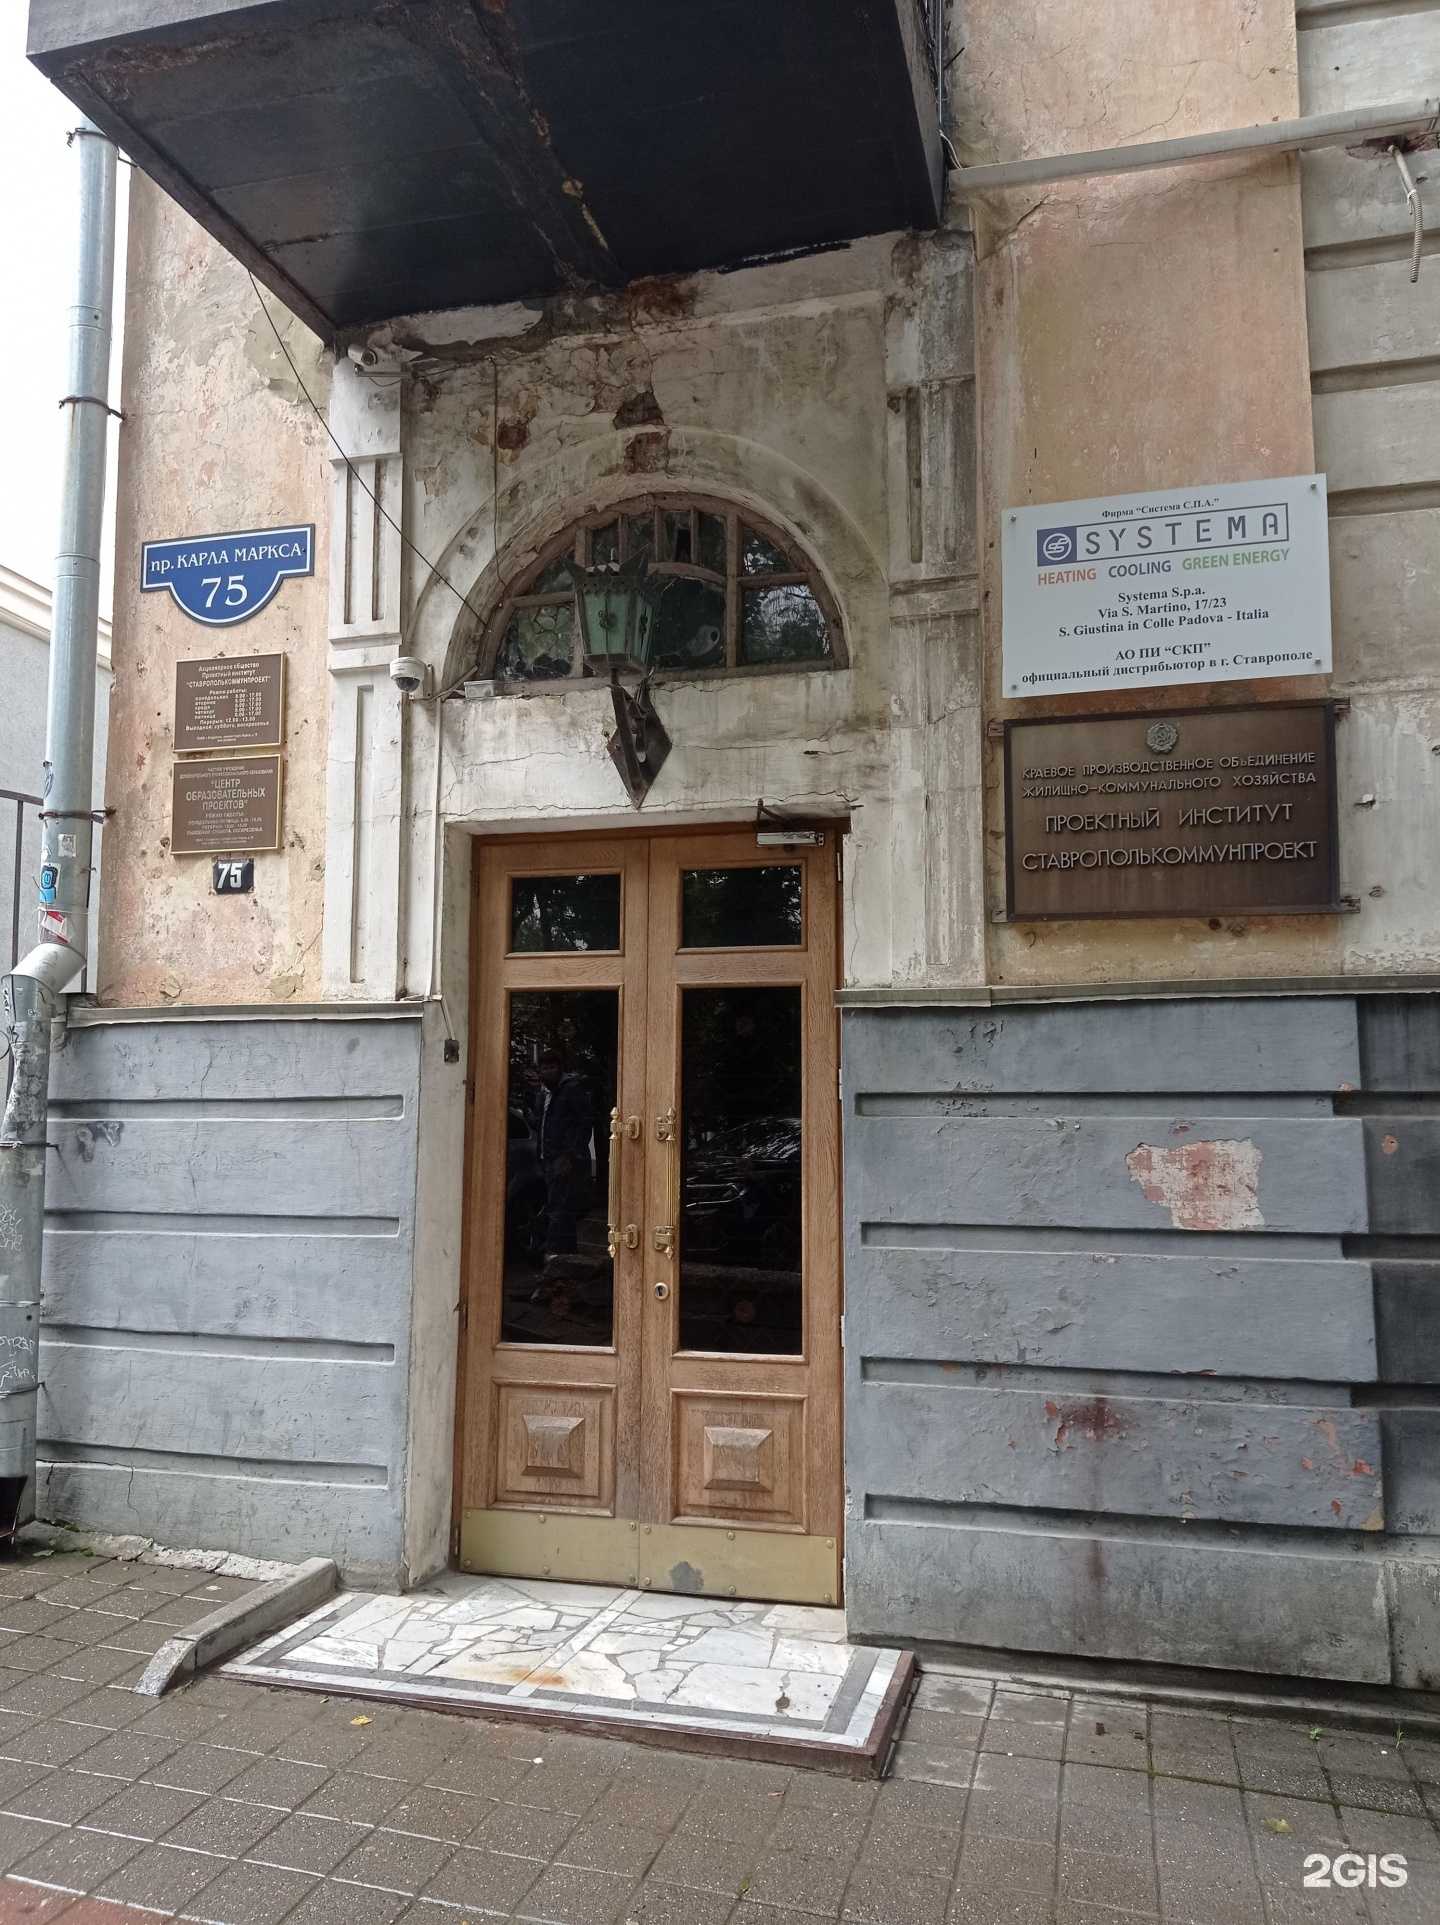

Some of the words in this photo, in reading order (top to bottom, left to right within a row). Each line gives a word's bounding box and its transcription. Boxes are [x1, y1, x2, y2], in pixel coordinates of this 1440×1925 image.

[1102, 509, 1134, 518] Фирма
[1085, 512, 1279, 555] SYSTEMA
[151, 559, 174, 574] пр.
[177, 550, 229, 568] КАРЛА
[234, 543, 302, 562] МАРКСА
[1037, 568, 1097, 586] HEATING
[1108, 560, 1172, 578] COOLING
[1182, 554, 1229, 570] GREEN
[1233, 548, 1291, 566] ENERGY
[201, 574, 248, 608] 75
[1118, 590, 1168, 604] Systema
[1171, 587, 1206, 599] S.p.a.
[1098, 608, 1118, 619] Via
[1121, 606, 1133, 617] S.
[1137, 602, 1191, 616] Martino,
[1195, 597, 1227, 610] 17/23
[1059, 627, 1070, 637] S.
[1073, 623, 1124, 636] Giustina
[1128, 621, 1139, 631] in
[1143, 618, 1175, 629] Colle
[1178, 614, 1224, 626] Padova
[1236, 609, 1269, 621] Italia
[1116, 649, 1136, 661] АО
[1139, 647, 1161, 659] ПИ
[1022, 666, 1110, 685] официальный
[1113, 659, 1205, 676] дистрибьютор
[1209, 659, 1217, 667] в
[1221, 658, 1229, 667] г.
[1233, 651, 1313, 666] Ставрополе
[1022, 766, 1075, 779] КРАЕВОЕ
[1083, 758, 1214, 775] ПРОИЗВОДСТВЕННОЕ
[1232, 772, 1317, 787] ХОЗЯЙСТВА
[186, 787, 266, 801] ОБРАЗОВАТЕЛЬНЫХ
[1045, 808, 1160, 832] ПРОЕКТНЫЙ
[1179, 803, 1293, 825] ИНСТИТУТ
[1022, 841, 1317, 870] СТАВРОПОЛЬКОММУНПРОЕКТ
[217, 862, 243, 889] 75
